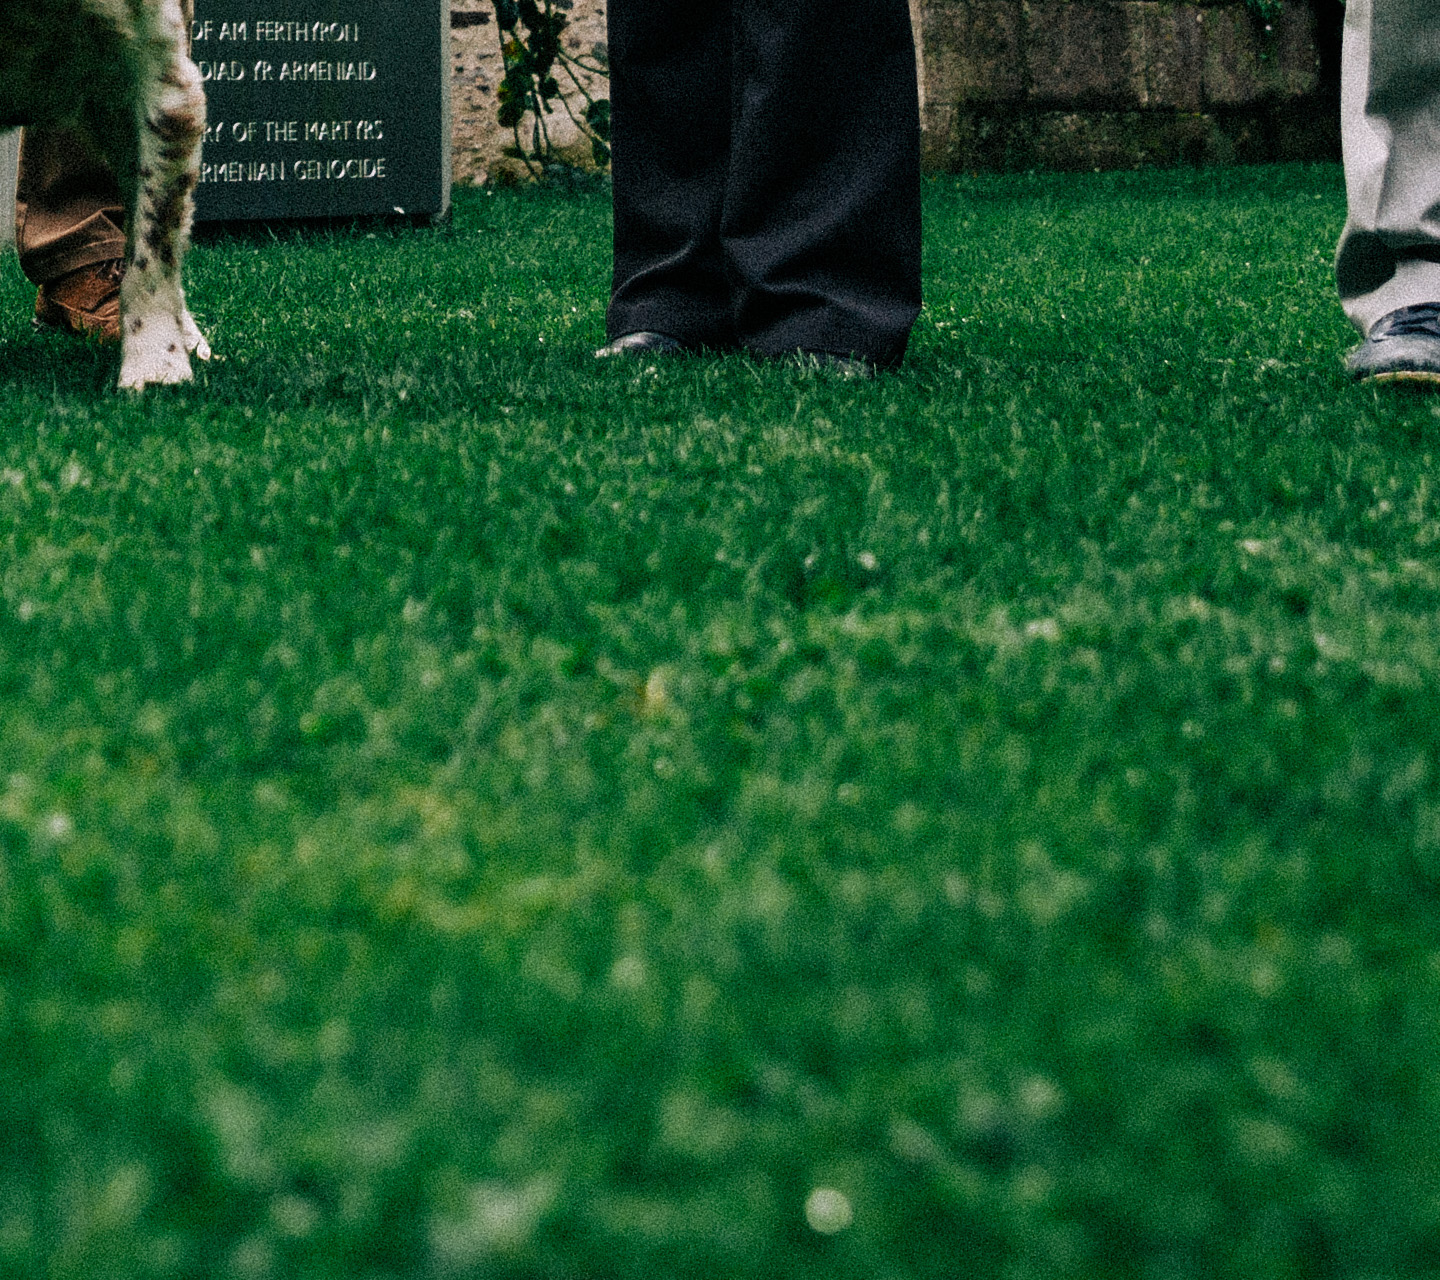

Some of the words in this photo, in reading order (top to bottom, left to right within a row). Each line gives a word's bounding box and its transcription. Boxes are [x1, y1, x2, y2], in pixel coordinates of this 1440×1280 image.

[191, 20, 213, 41] OF
[219, 21, 247, 42] AM
[256, 20, 359, 42] FERTHYRON
[198, 60, 245, 82] DIAD
[253, 60, 274, 81] YR
[280, 60, 377, 82] ARMENIAID
[232, 121, 258, 143] OF
[263, 121, 298, 142] THE
[305, 120, 384, 142] MARTYRS
[199, 161, 285, 182] RMENIAN
[293, 158, 387, 181] GENOCIDE
